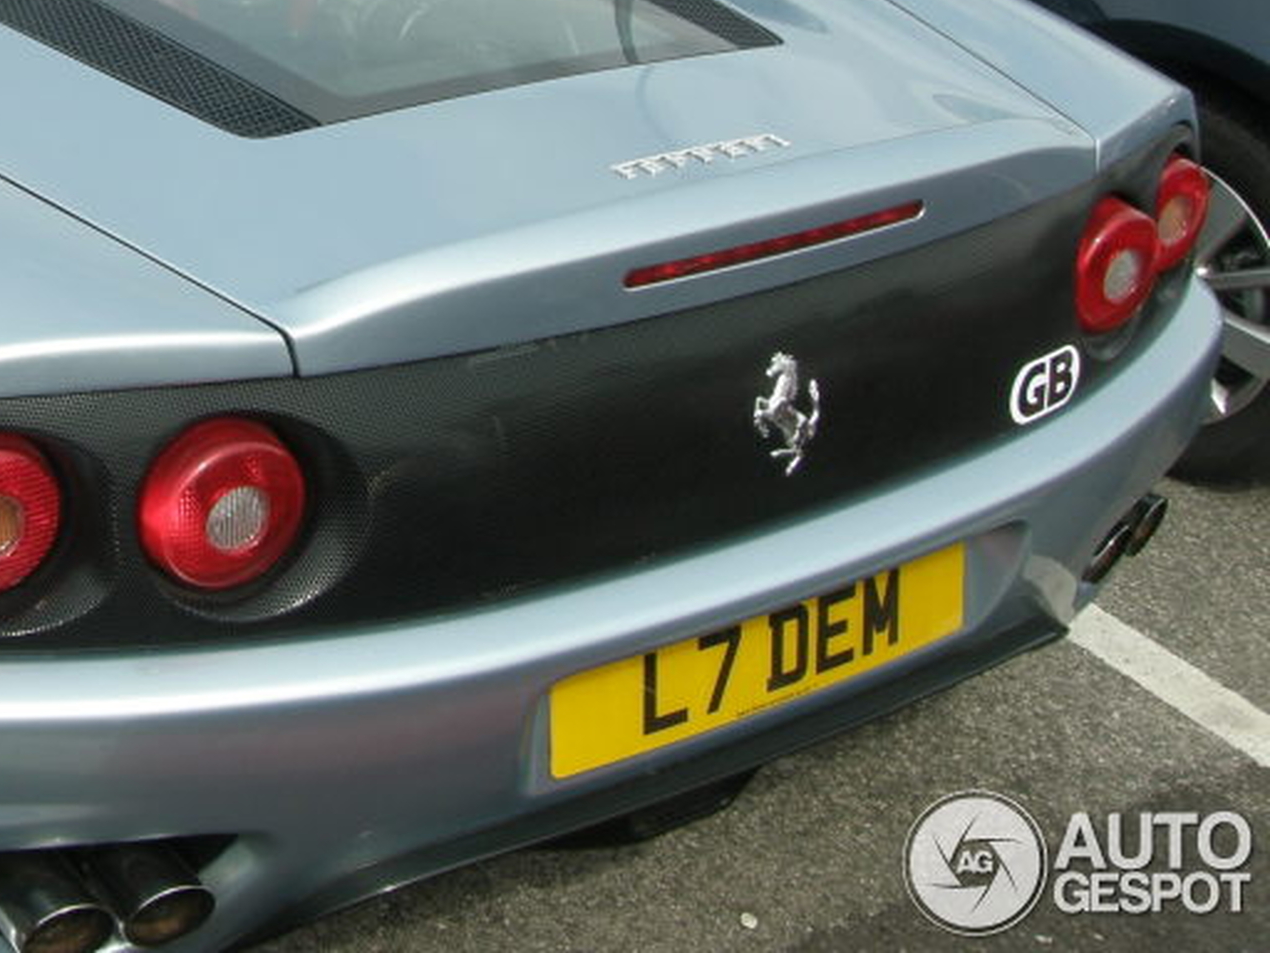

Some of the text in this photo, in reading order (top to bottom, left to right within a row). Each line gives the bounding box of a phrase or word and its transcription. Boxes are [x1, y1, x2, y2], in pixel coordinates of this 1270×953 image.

[1017, 349, 1074, 418] GB
[642, 566, 901, 736] L7 DEM
